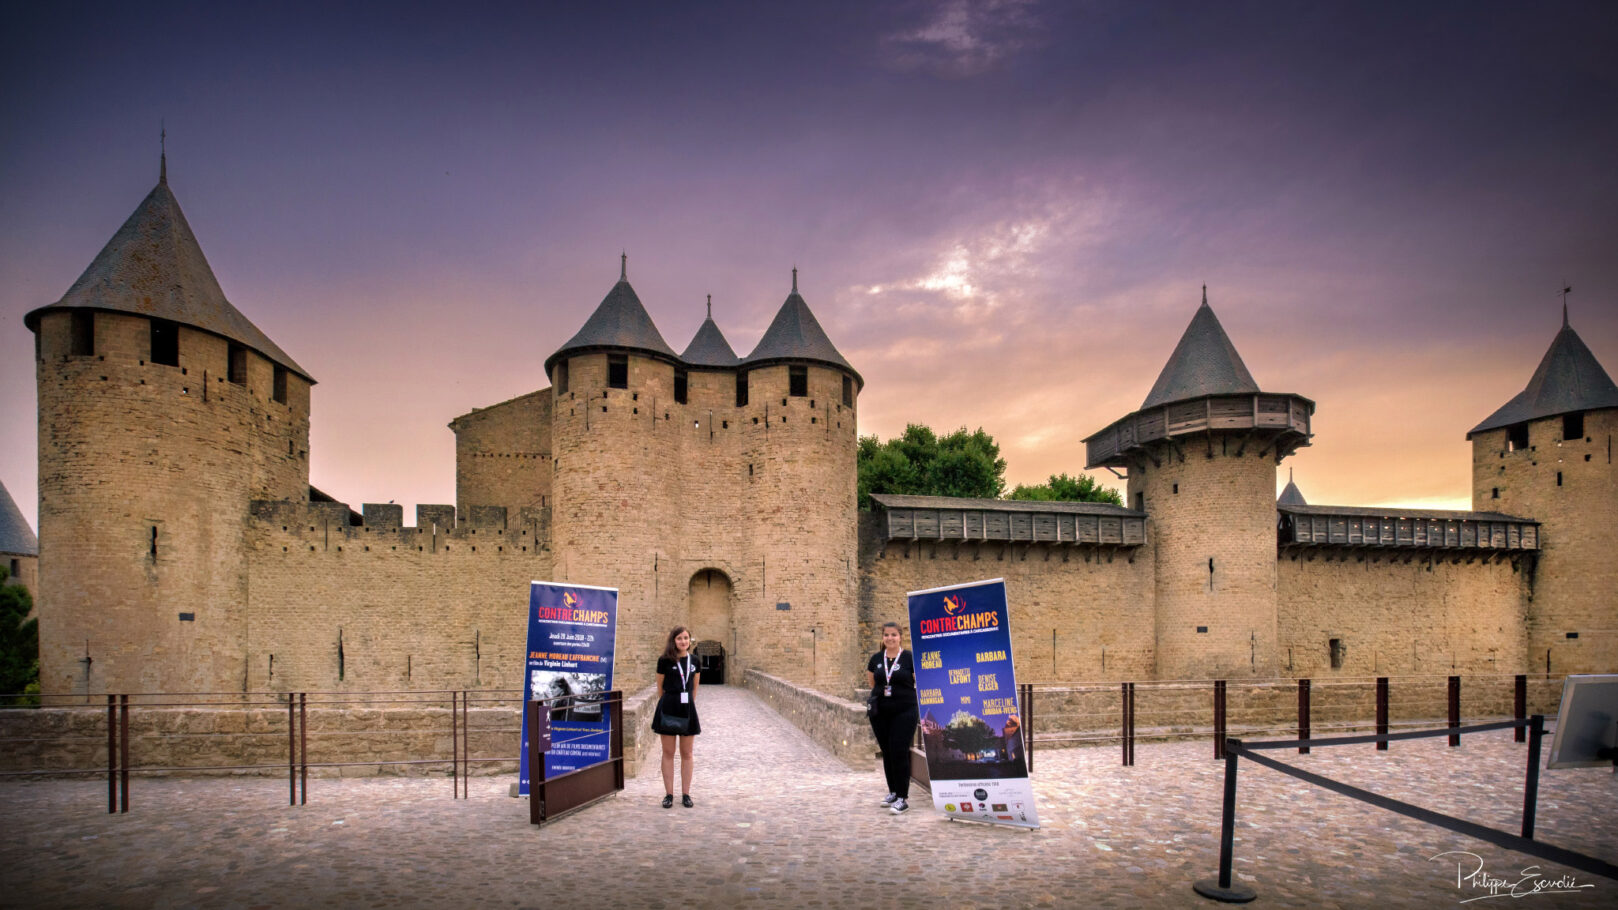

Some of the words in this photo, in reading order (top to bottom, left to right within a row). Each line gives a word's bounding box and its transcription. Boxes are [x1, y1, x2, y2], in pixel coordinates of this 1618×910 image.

[538, 606, 608, 624] CONTRECHAMPS
[920, 611, 998, 634] CONTRECHAMPS
[922, 651, 941, 660] JEANNE
[976, 650, 1006, 663] BARBARA
[921, 659, 942, 670] MOREAU
[950, 674, 971, 684] LAFONT
[978, 674, 996, 682] DENISE
[920, 688, 941, 698] BARBARA
[983, 697, 1014, 708] MARCELINE
